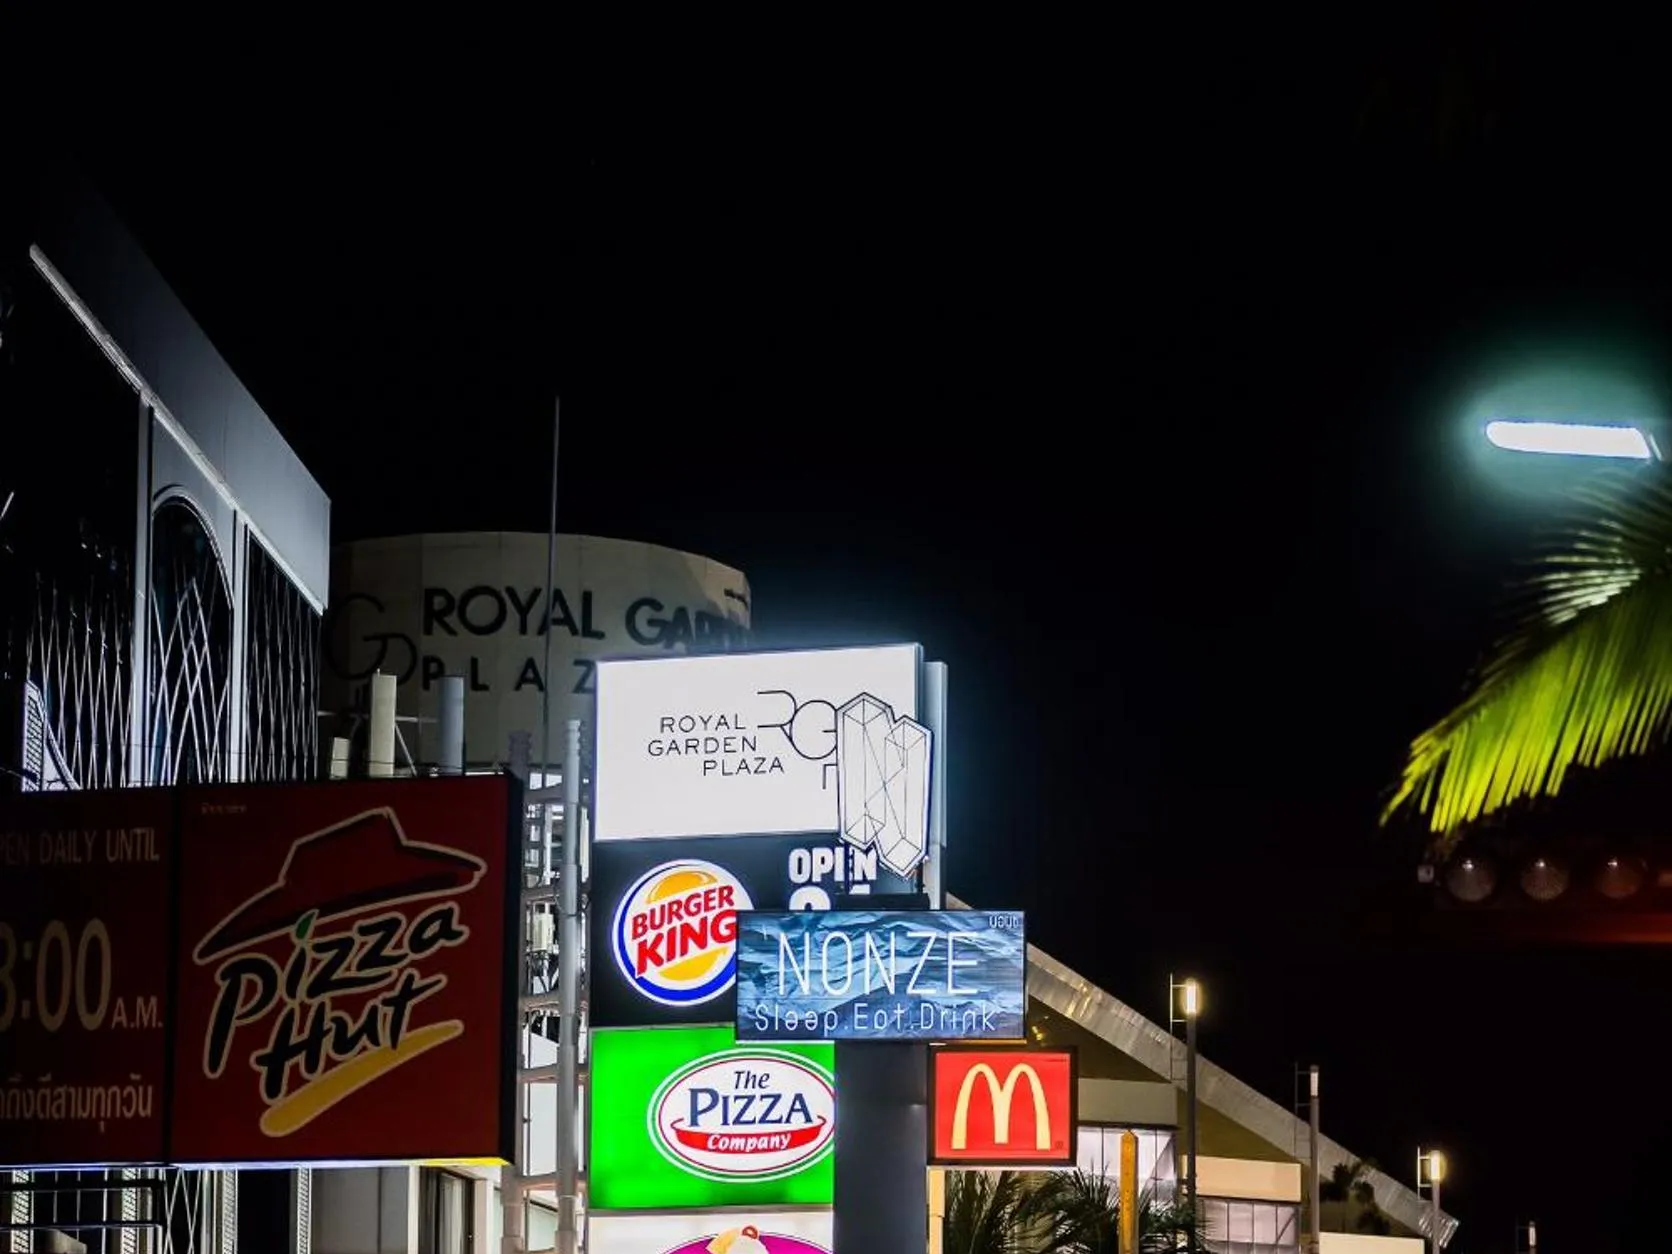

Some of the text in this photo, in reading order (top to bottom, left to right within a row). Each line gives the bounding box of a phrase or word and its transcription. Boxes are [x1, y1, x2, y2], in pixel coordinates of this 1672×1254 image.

[422, 585, 606, 640] ROYAL
[421, 655, 597, 694] PLAZ
[660, 713, 747, 734] ROYAL
[647, 735, 758, 757] GARDEN
[702, 757, 785, 777] PLAZA
[38, 828, 98, 866] DAILY
[105, 826, 161, 864] UNTIL
[631, 884, 736, 941] BURGER
[634, 910, 738, 976] KING
[777, 931, 979, 996] NONZE
[204, 901, 469, 1079] Pizza
[111, 995, 164, 1030] A.M.
[250, 974, 447, 1100] Hut
[733, 1069, 771, 1091] The
[688, 1087, 814, 1128] PIZZA
[706, 1133, 791, 1154] Company
